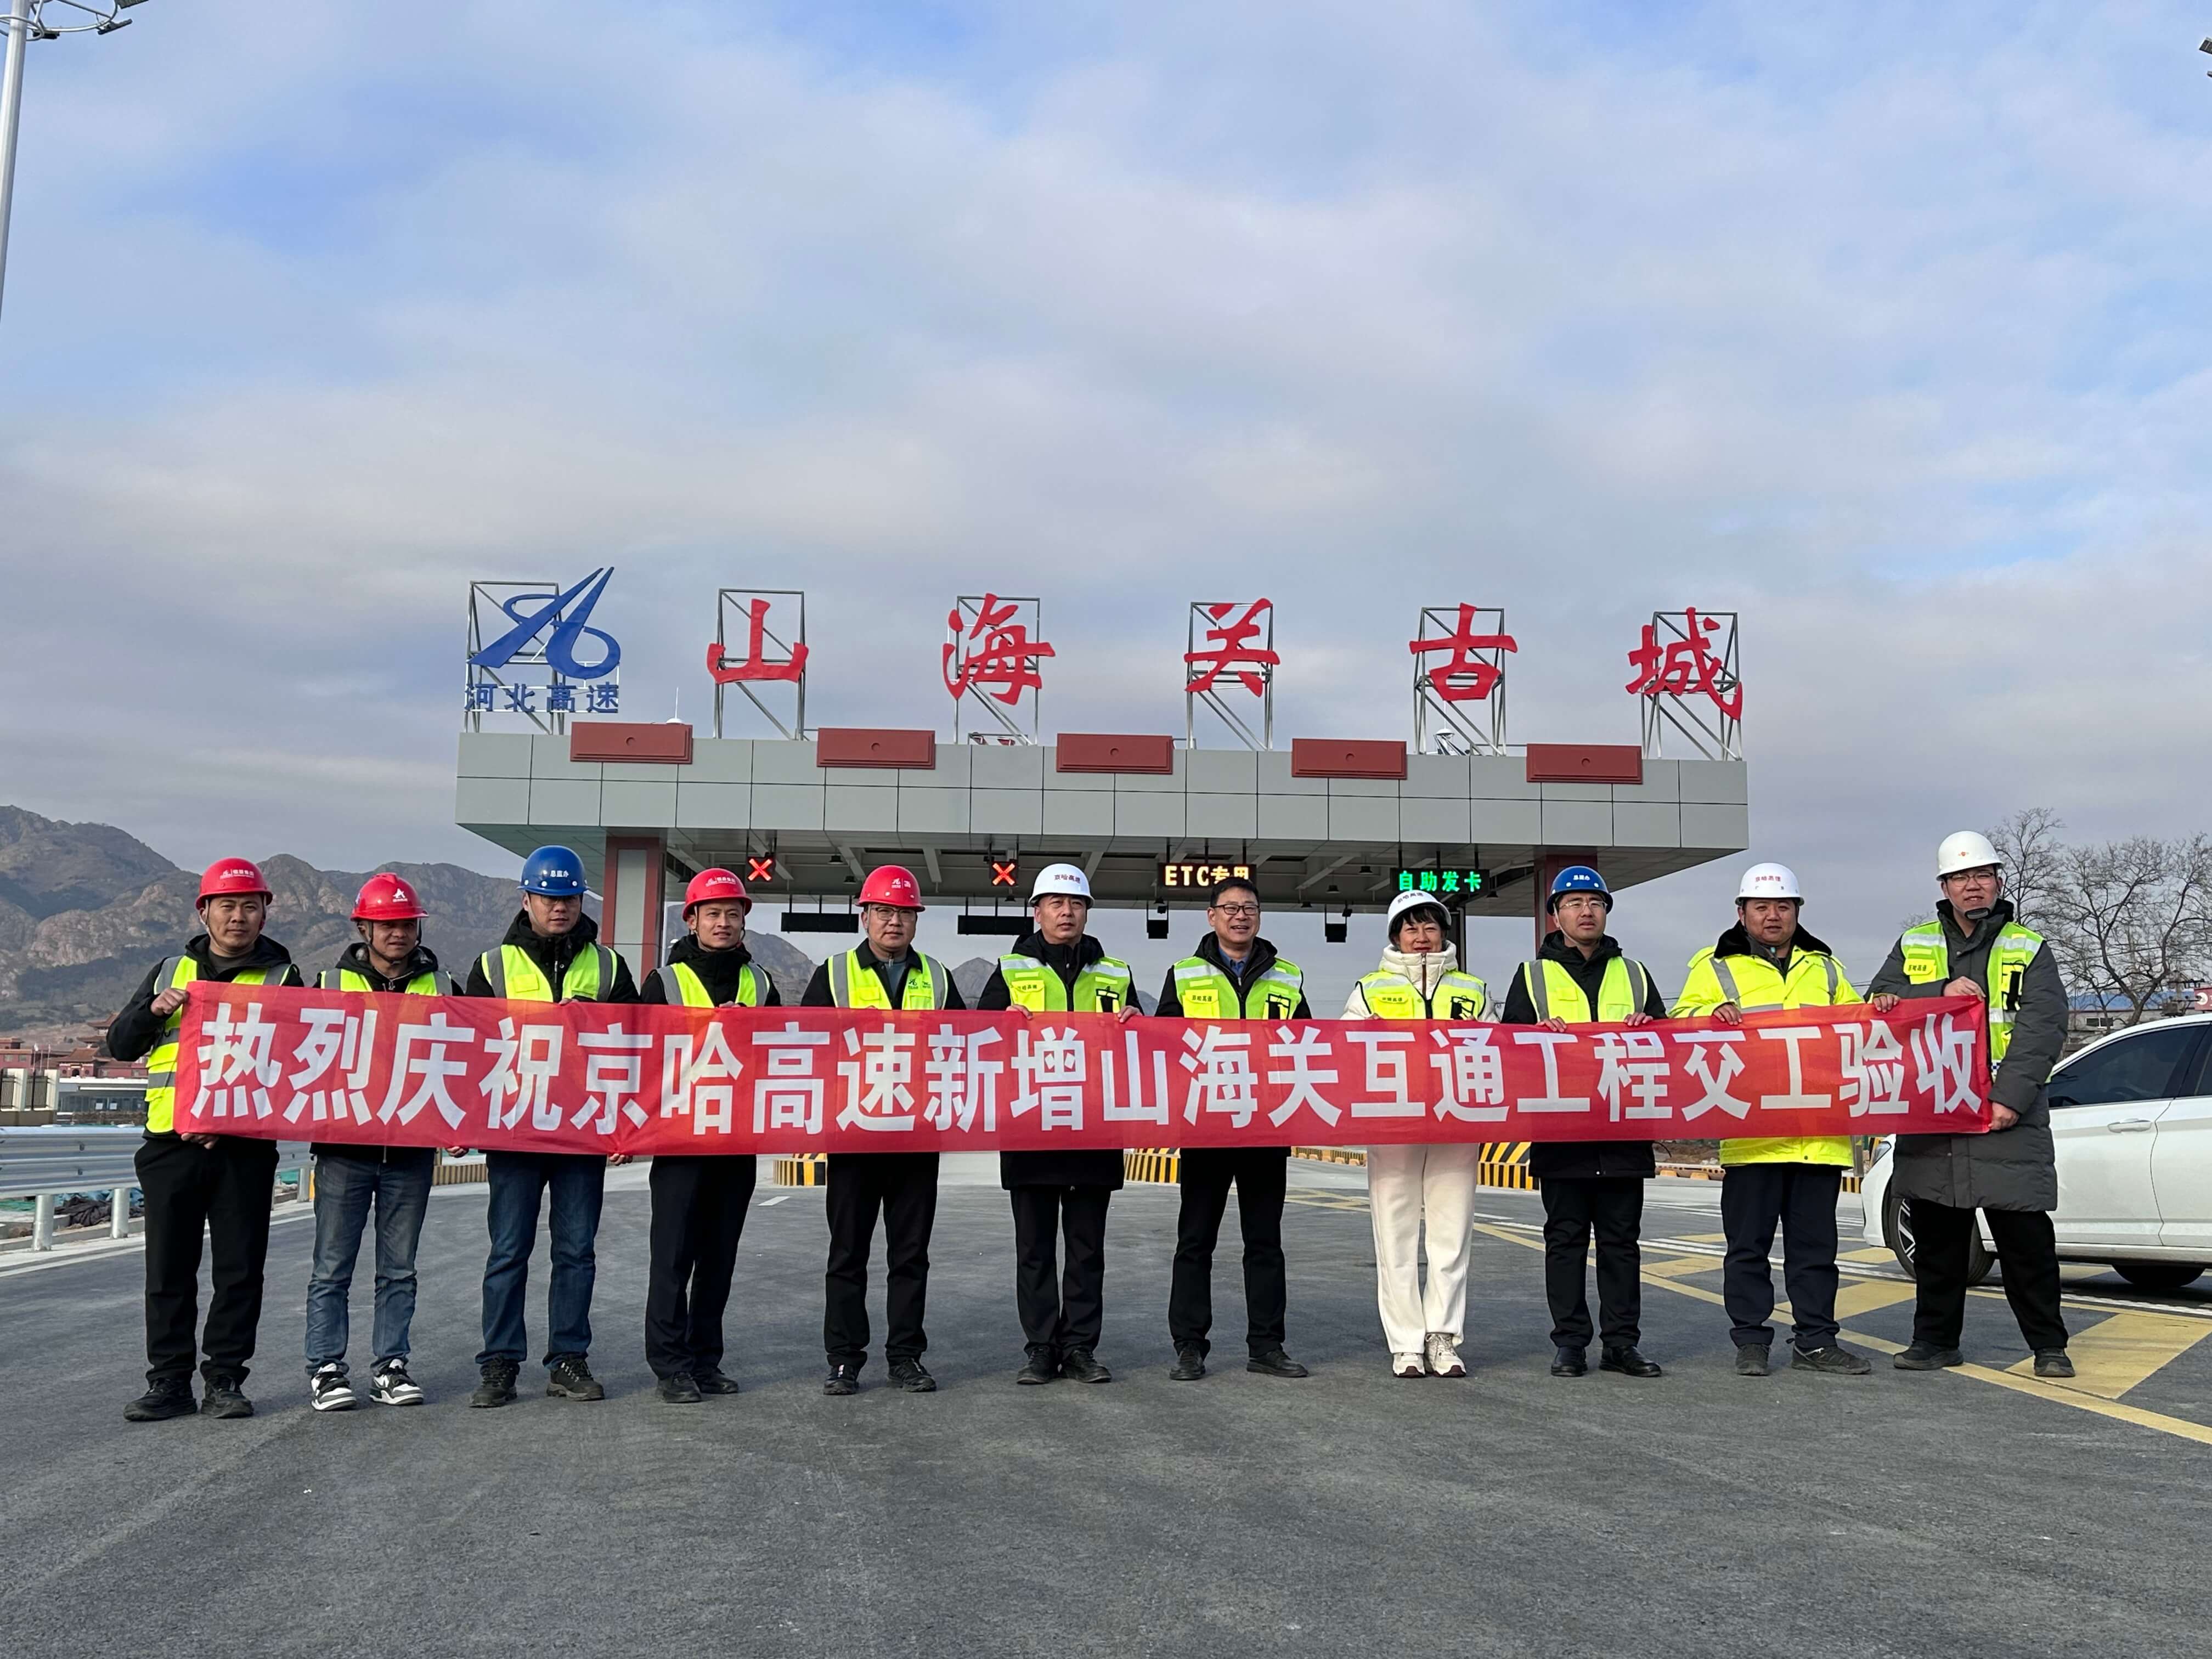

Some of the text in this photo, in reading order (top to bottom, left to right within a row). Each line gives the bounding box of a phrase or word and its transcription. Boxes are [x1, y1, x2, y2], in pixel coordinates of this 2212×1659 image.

[707, 594, 1742, 720] 山海关古城
[465, 681, 619, 713] 河北高速
[1400, 870, 1482, 892] 自助发卡
[191, 1002, 1982, 1135] 热烈庆祝京哈高速新增山海关互通工程交工验收
